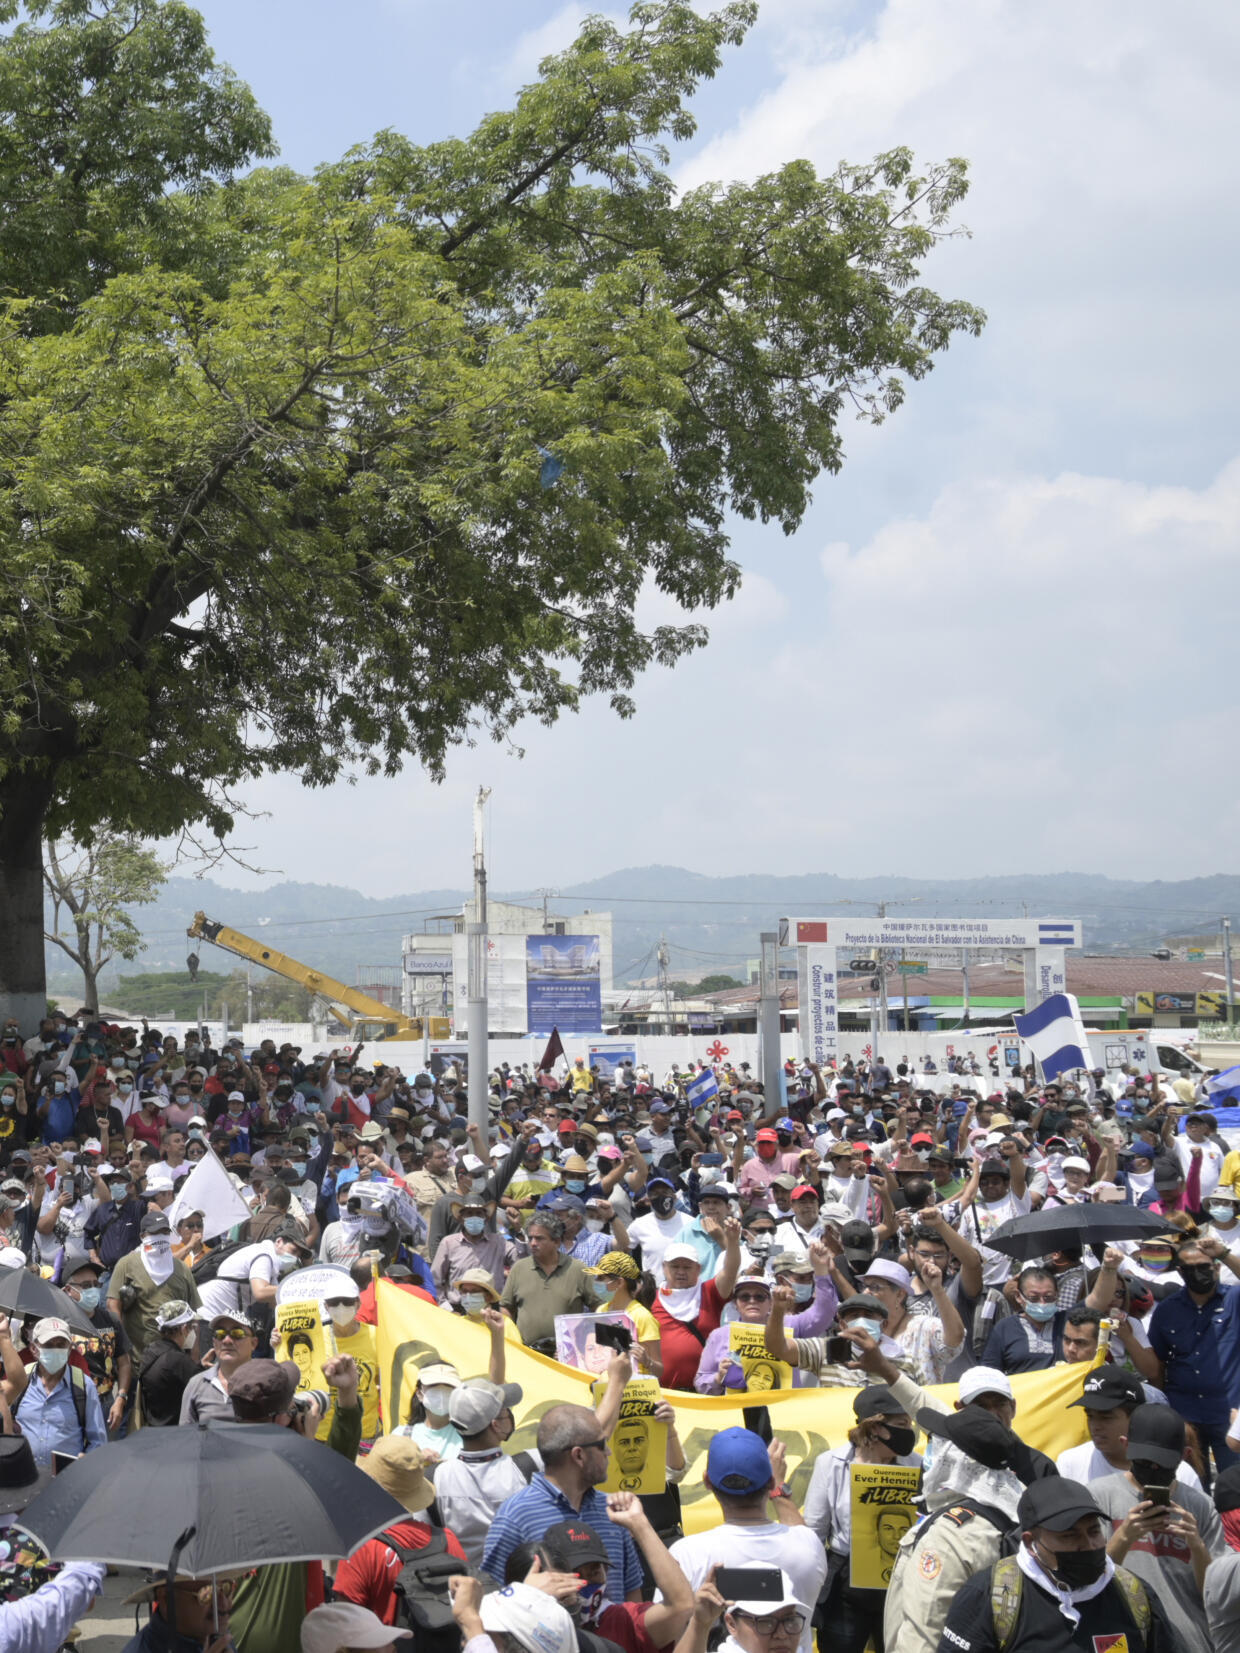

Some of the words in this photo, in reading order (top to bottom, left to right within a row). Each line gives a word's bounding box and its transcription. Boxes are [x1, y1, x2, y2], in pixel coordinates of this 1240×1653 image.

[845, 933, 867, 945] Proyecto
[868, 934, 874, 943] de
[881, 933, 905, 944] Biblioteca
[906, 934, 927, 944] Nacional
[928, 934, 934, 944] de
[941, 934, 962, 944] Salvador
[963, 936, 972, 944] con
[979, 934, 1004, 945] Asistencia
[1012, 935, 1026, 945] China
[434, 961, 448, 969] Azul
[812, 965, 823, 997] Construir
[811, 999, 824, 1034] proyectos
[815, 1036, 825, 1045] de
[282, 1317, 312, 1332] ¡LIBRE!
[734, 1335, 757, 1343] Vanda
[739, 1345, 776, 1360] ¡LIBRE
[633, 1390, 656, 1398] Roque
[620, 1401, 654, 1417] IBRE!
[873, 1469, 910, 1477] Queremos
[855, 1474, 878, 1483] Ever
[881, 1476, 916, 1487] Henriq
[866, 1487, 918, 1505] ¡LIBRE
